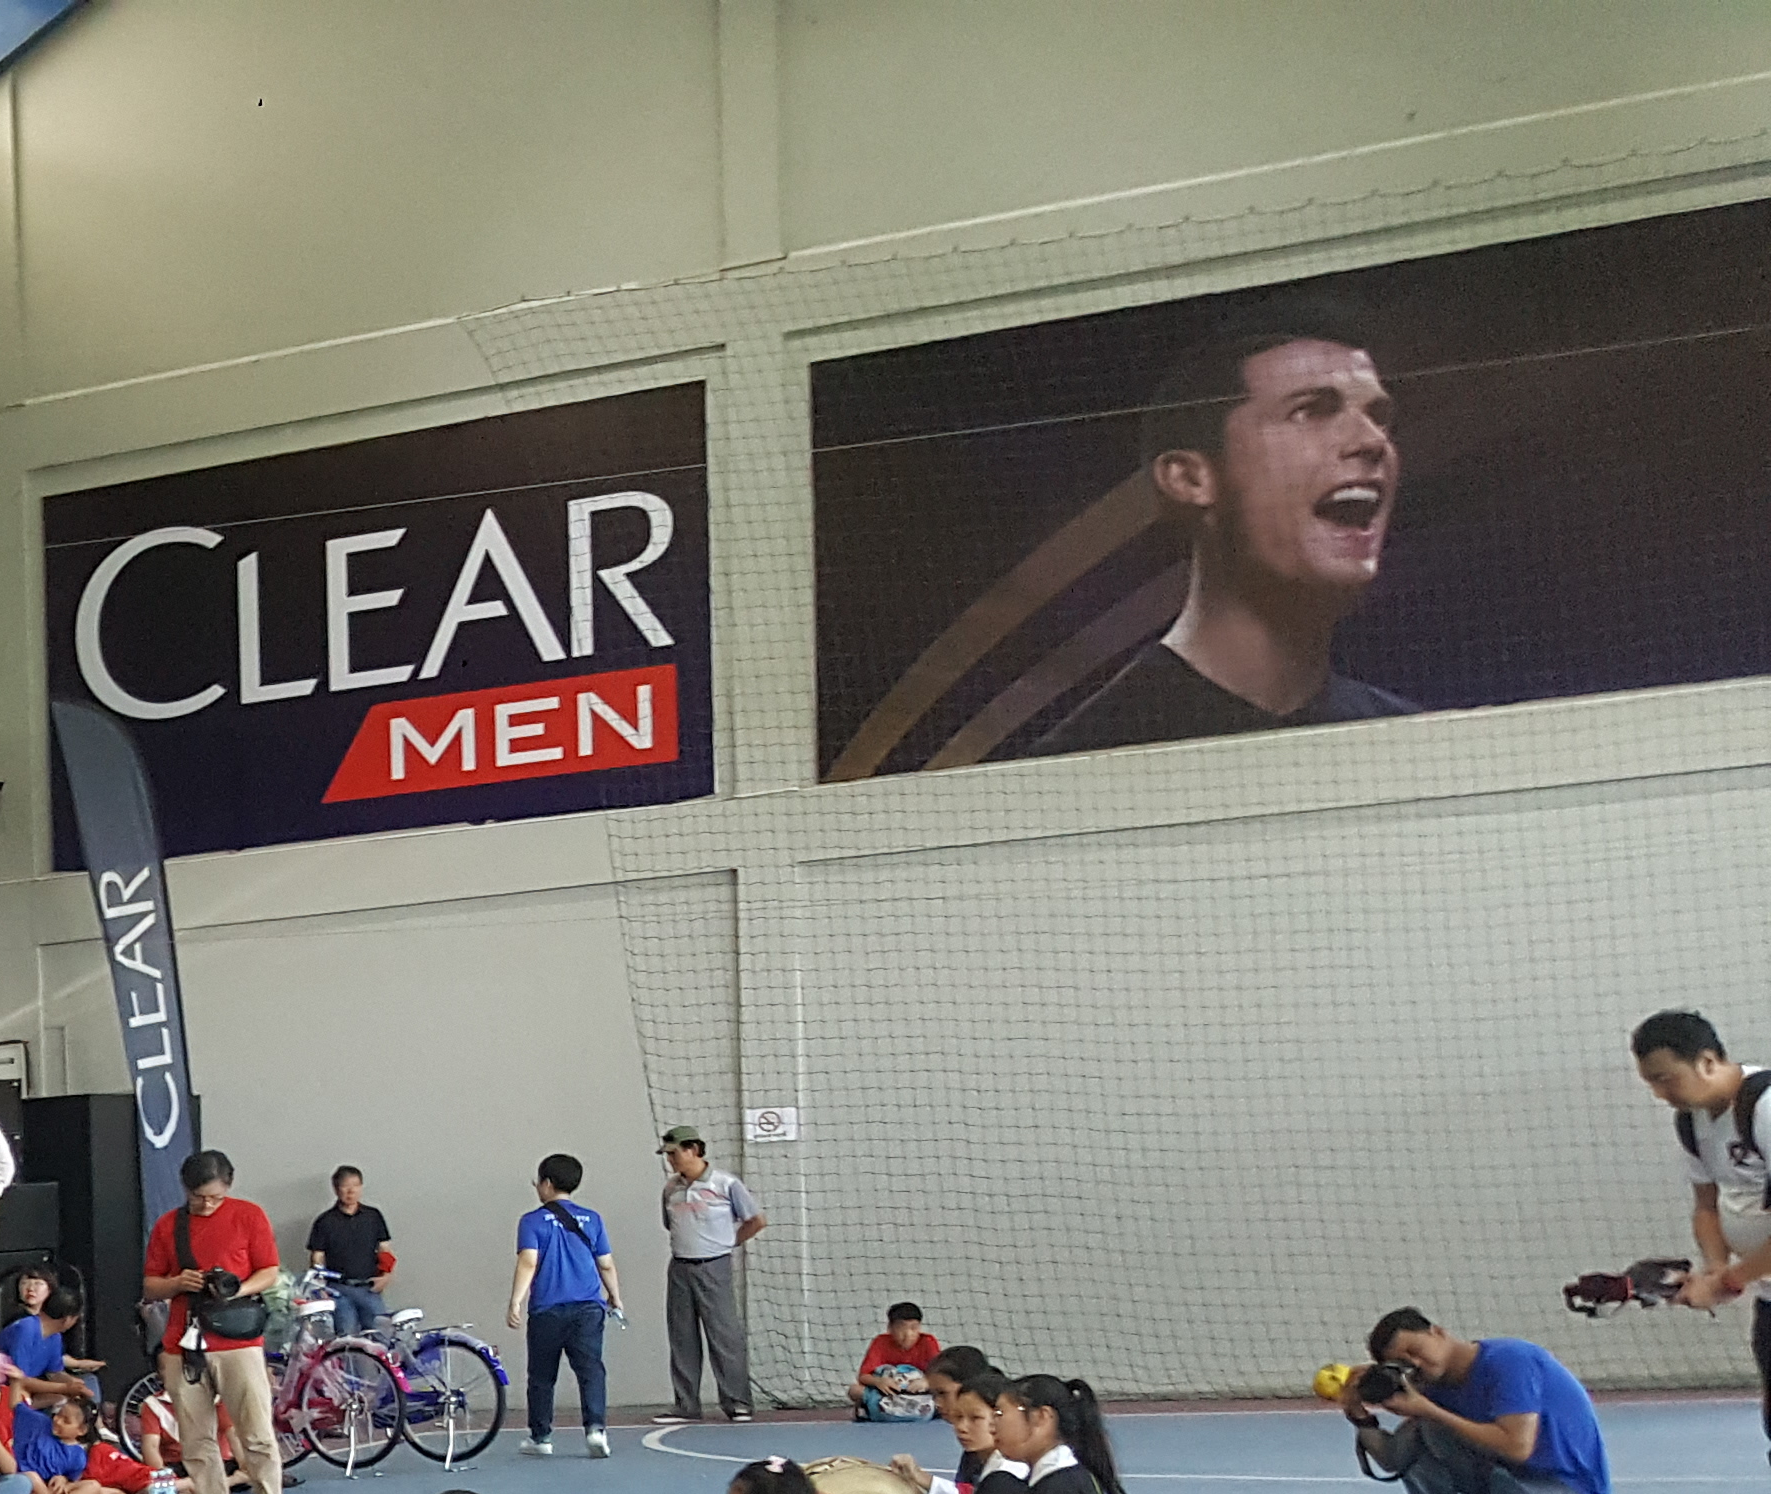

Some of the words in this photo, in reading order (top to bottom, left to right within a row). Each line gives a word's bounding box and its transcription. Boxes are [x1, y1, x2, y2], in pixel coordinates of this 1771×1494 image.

[75, 491, 675, 720] CLEAR
[389, 684, 654, 781] MEN
[100, 866, 180, 1149] CLEAR
